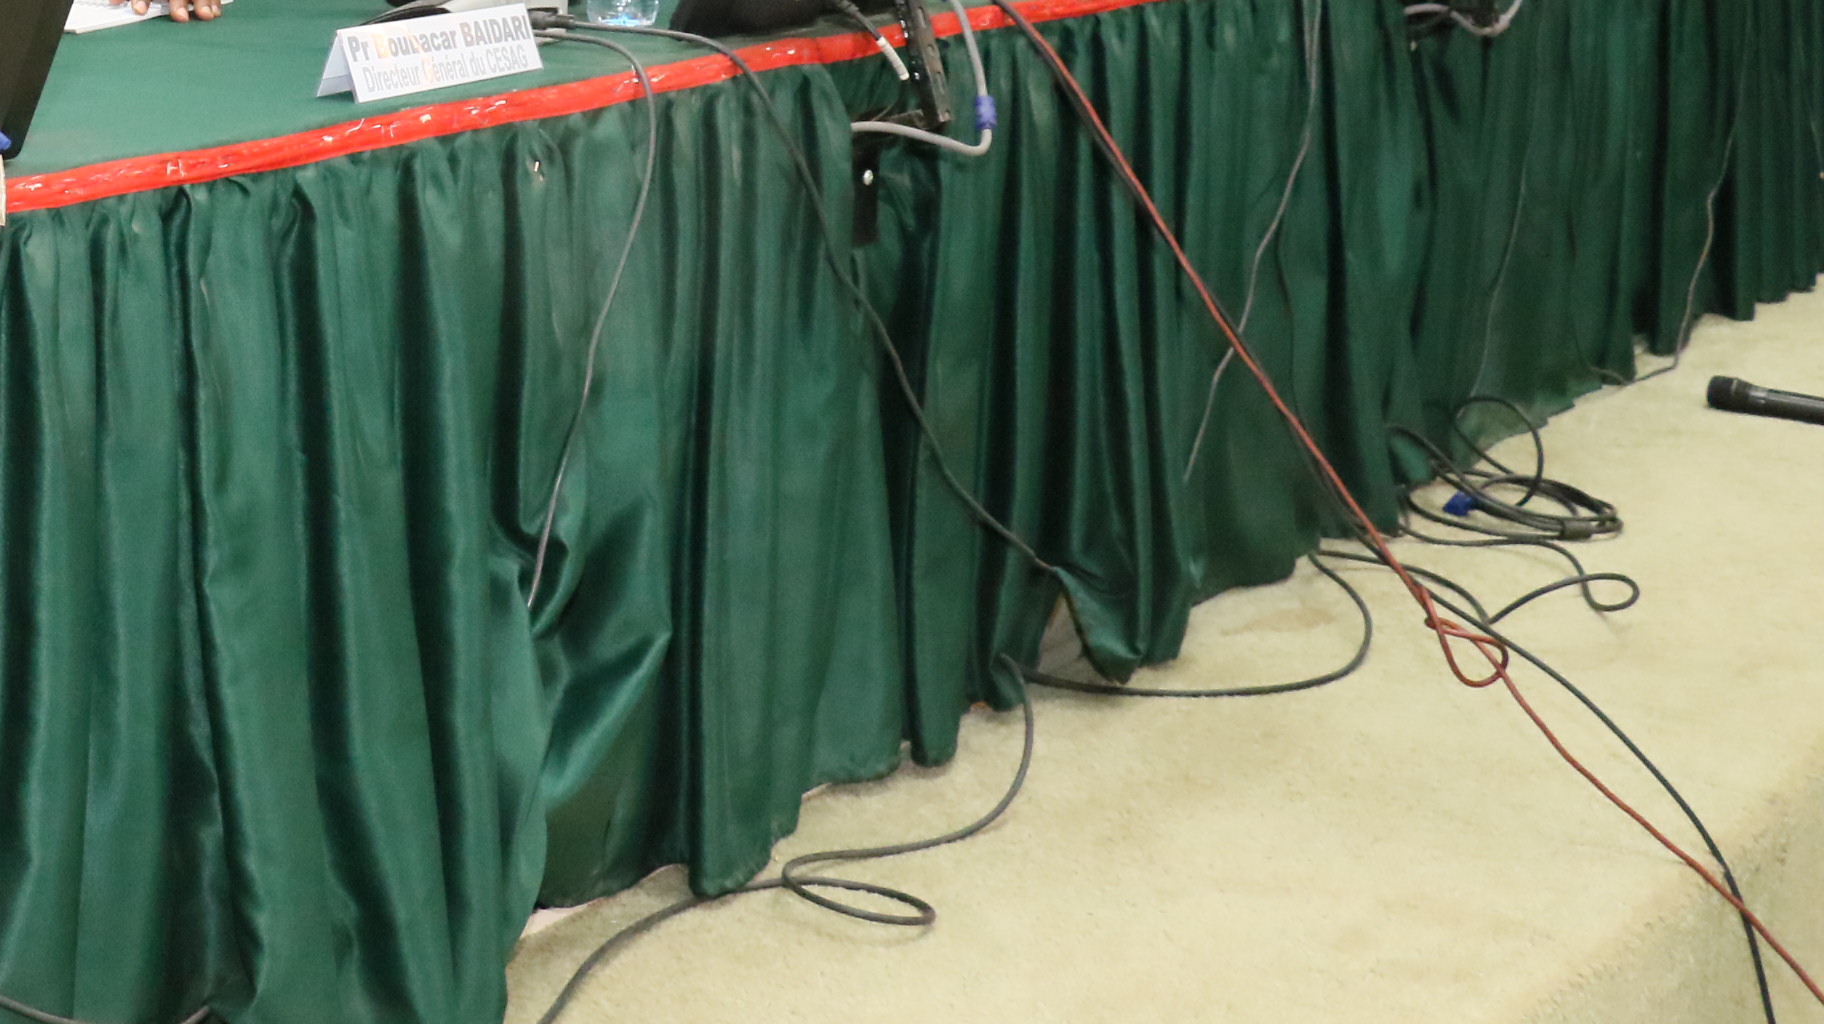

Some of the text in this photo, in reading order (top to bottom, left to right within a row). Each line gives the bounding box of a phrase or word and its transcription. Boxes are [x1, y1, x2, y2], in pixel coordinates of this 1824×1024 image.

[347, 36, 370, 62] Pr
[459, 15, 531, 47] BAIDARI
[362, 61, 421, 93] Directeur
[469, 49, 487, 76] du
[486, 44, 528, 73] CESAG
